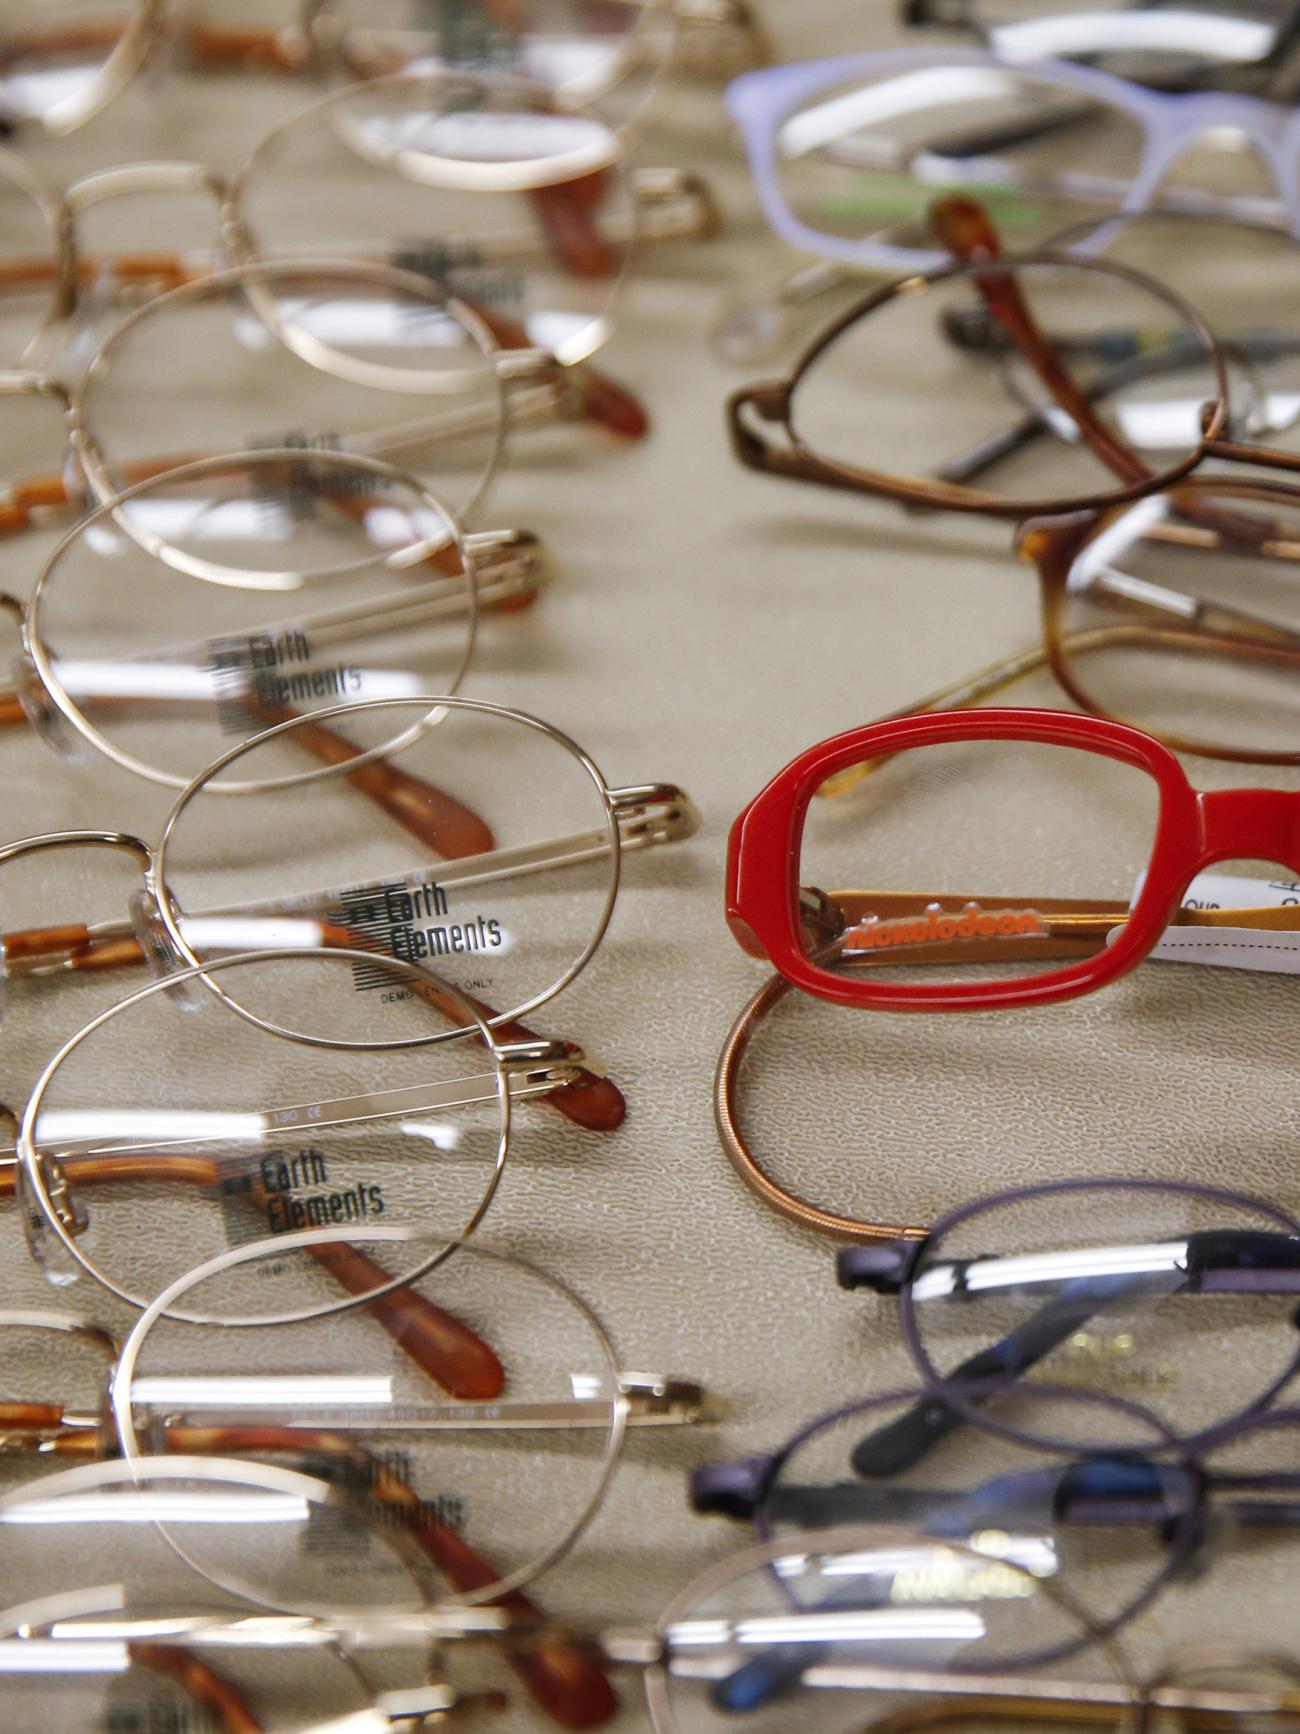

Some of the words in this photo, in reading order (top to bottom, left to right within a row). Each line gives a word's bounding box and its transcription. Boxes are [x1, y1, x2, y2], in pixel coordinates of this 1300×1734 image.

[383, 876, 448, 923] Earth
[390, 914, 502, 966] Elements
[381, 990, 414, 1004] DEMO
[464, 976, 494, 992] ONLY
[260, 1149, 328, 1194] Earth
[267, 1181, 385, 1234] Elements
